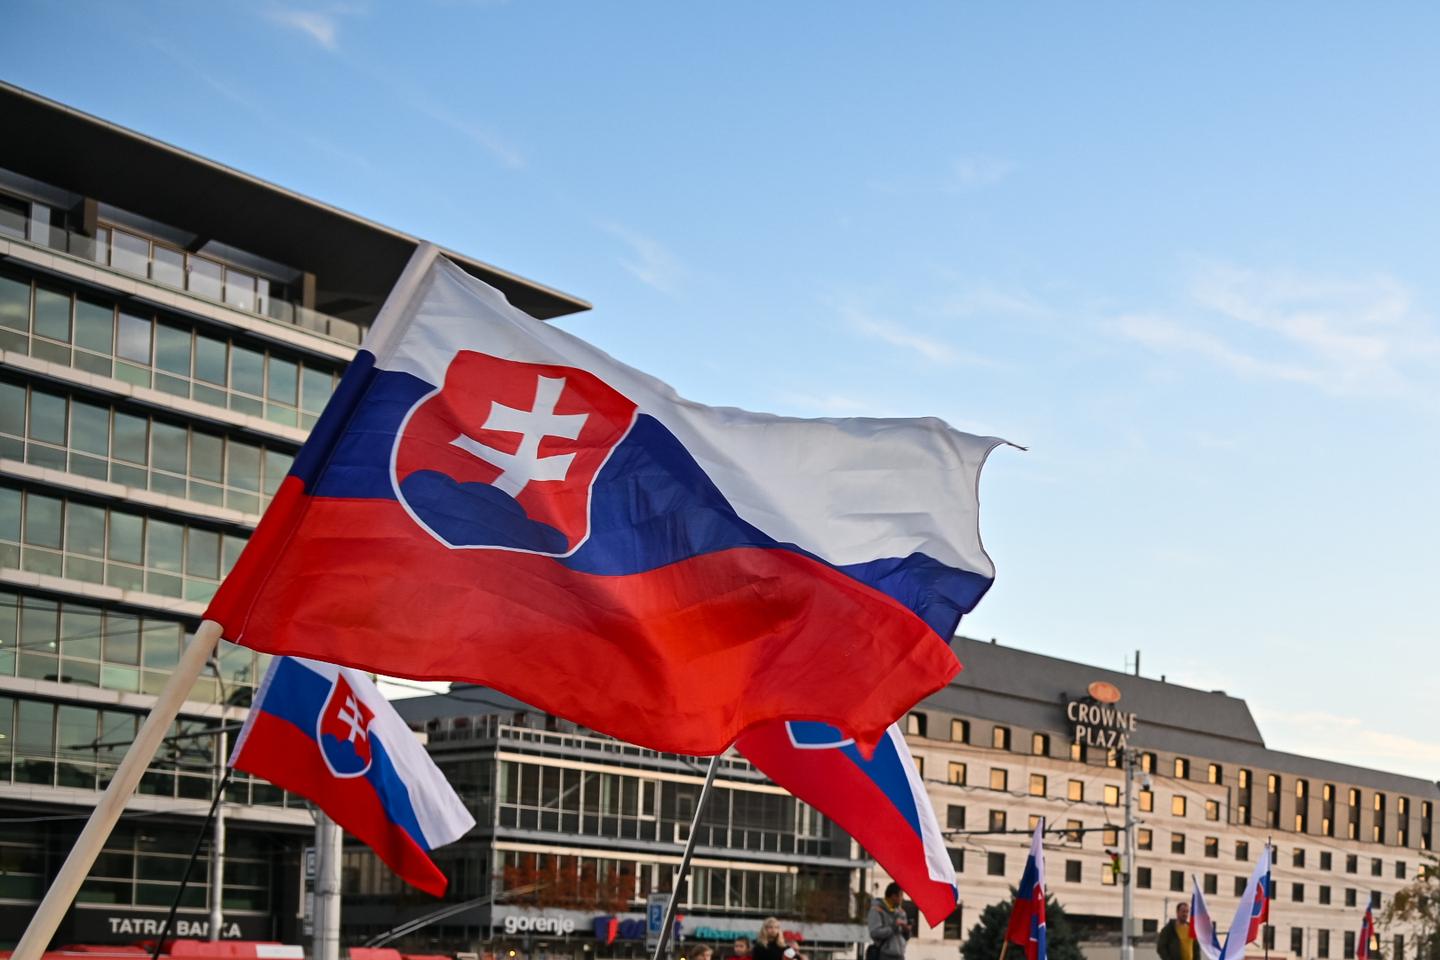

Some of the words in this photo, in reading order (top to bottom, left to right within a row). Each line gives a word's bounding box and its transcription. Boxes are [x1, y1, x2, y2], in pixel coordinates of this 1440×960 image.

[1067, 701, 1137, 732] CROWNE
[1075, 724, 1127, 749] PLAZA
[504, 915, 575, 936] gorenje
[696, 926, 757, 940] Hisen
